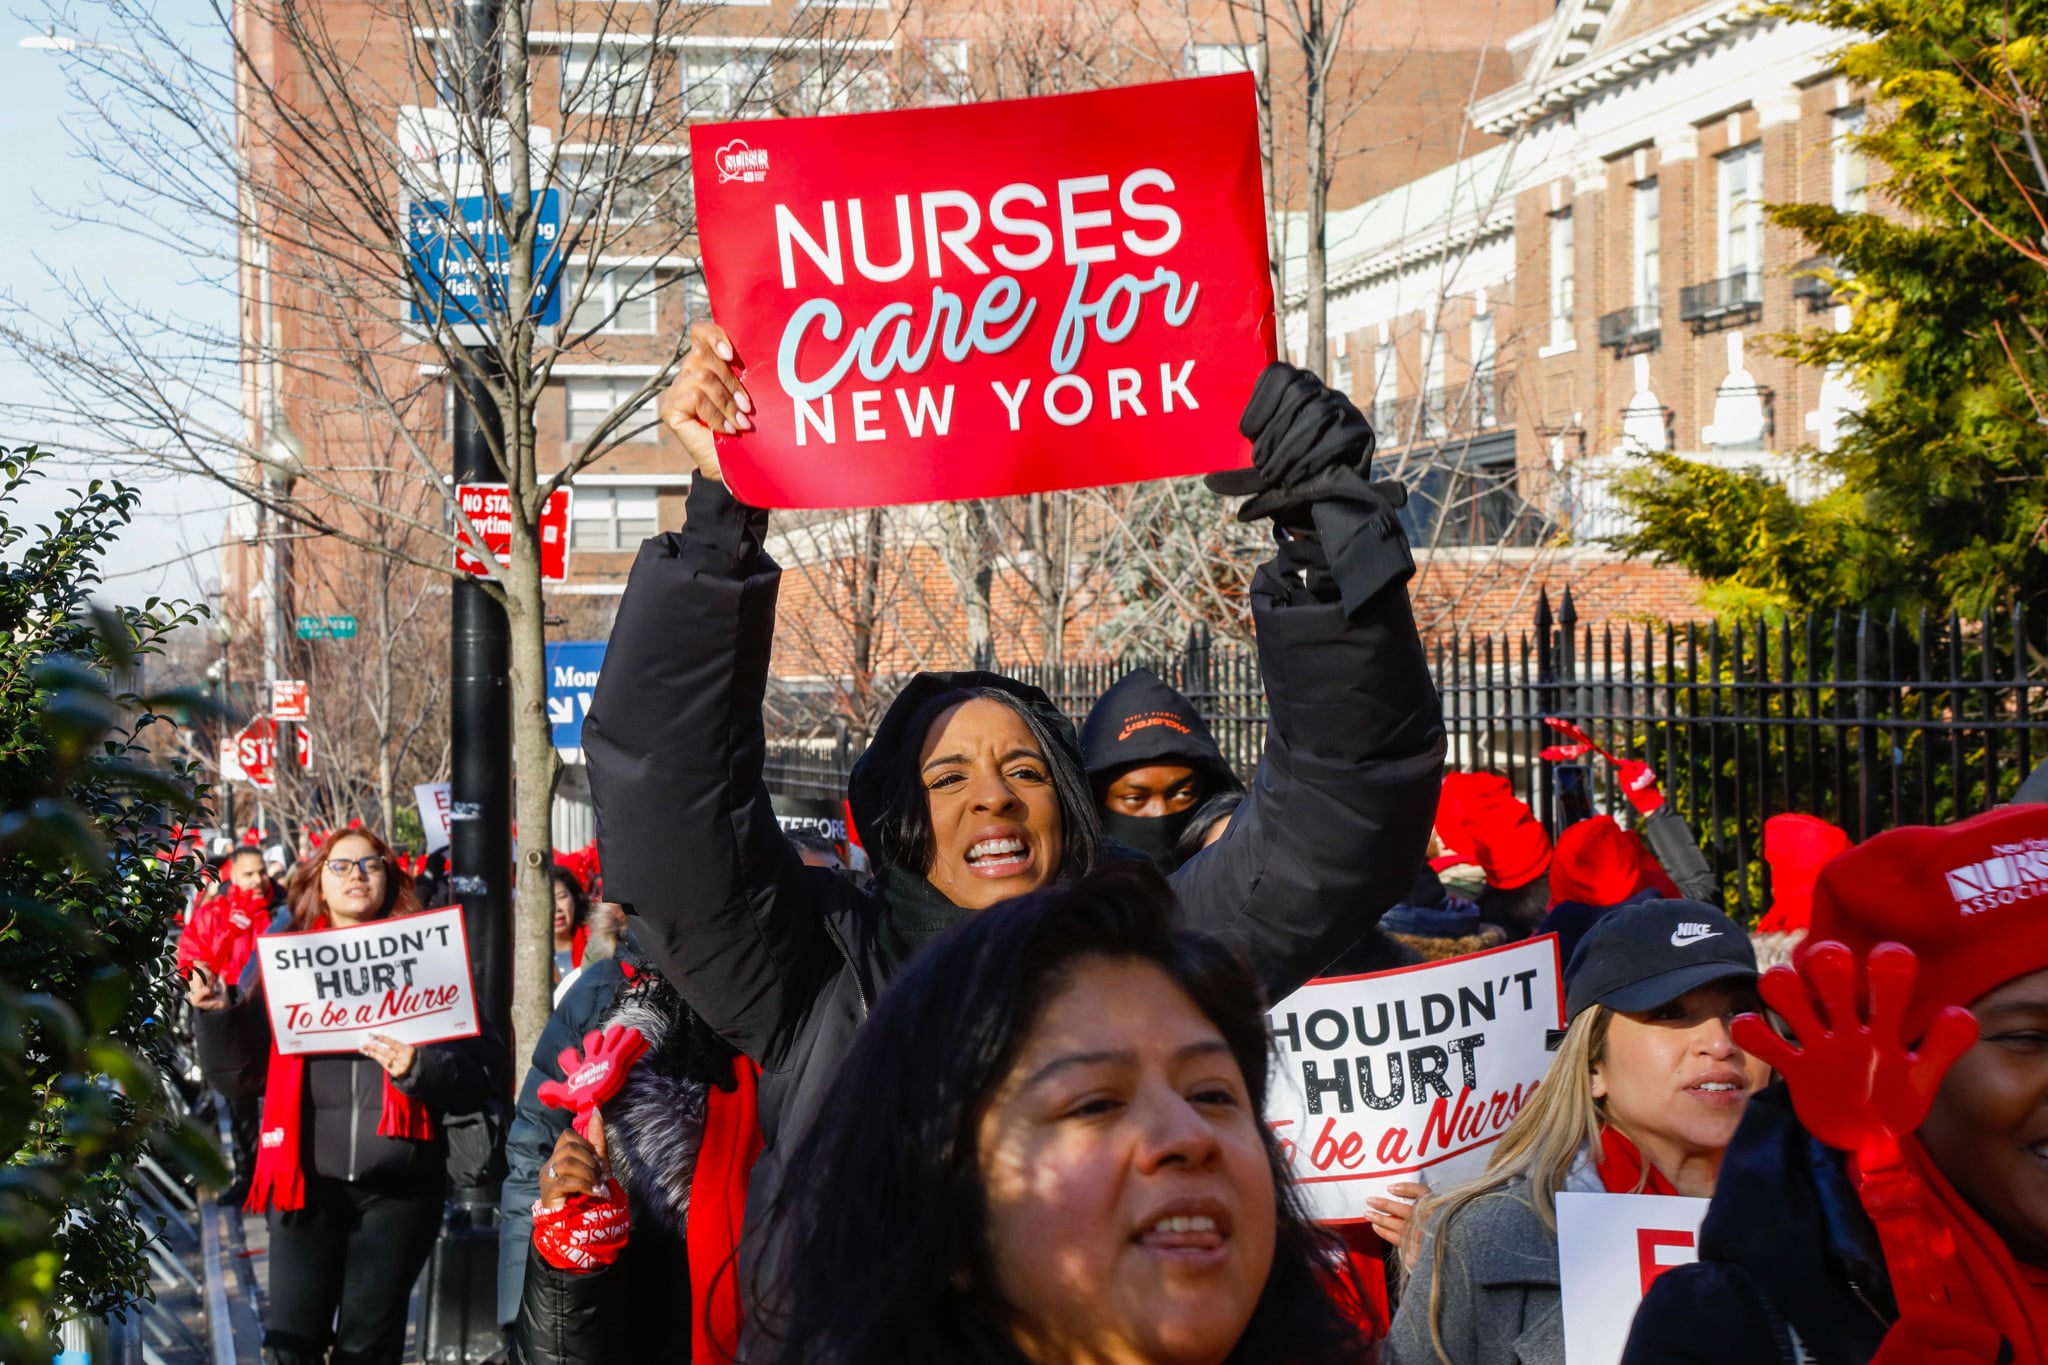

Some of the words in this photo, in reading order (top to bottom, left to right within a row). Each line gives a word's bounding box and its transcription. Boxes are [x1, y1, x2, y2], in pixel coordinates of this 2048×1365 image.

[775, 168, 1182, 290] NURSES
[776, 275, 1037, 401] Care
[1050, 260, 1199, 375] for
[793, 384, 955, 446] NEW
[991, 360, 1200, 432] YORK
[462, 494, 483, 513] NO
[554, 666, 601, 688] Mon
[275, 925, 449, 970] SHOULDN'T
[1677, 922, 1712, 937] NIKE
[314, 958, 418, 999] HURT
[285, 1002, 312, 1030] To
[320, 1001, 349, 1027] be
[355, 1004, 374, 1024] a
[377, 984, 460, 1019] Nurse
[1267, 968, 1538, 1052] HOULDN'T
[1301, 1033, 1485, 1115] HURT
[1310, 1116, 1367, 1171] be
[1376, 1127, 1413, 1164] a
